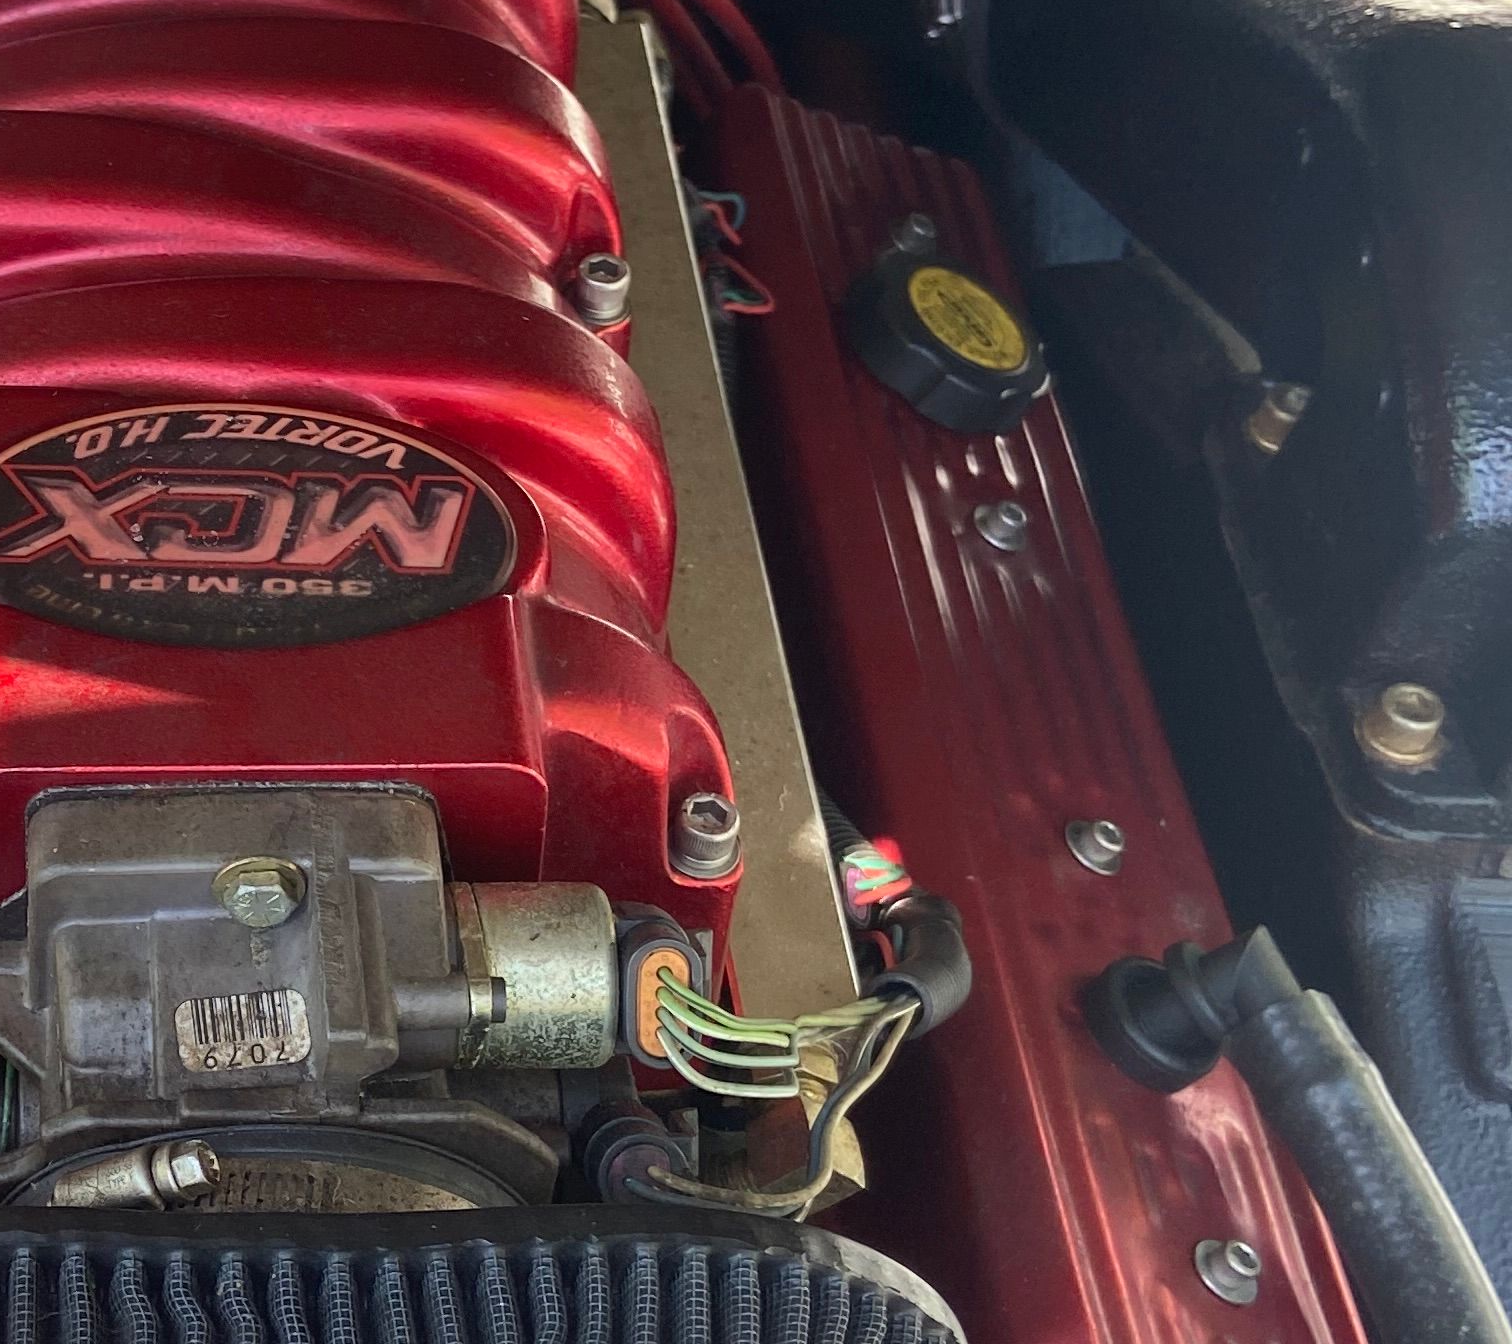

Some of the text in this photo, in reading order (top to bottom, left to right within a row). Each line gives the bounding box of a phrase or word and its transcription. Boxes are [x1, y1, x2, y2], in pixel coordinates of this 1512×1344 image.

[184, 413, 406, 469] VORTEC
[84, 572, 373, 597] 350 M.P.I.
[203, 1041, 290, 1070] 7079
